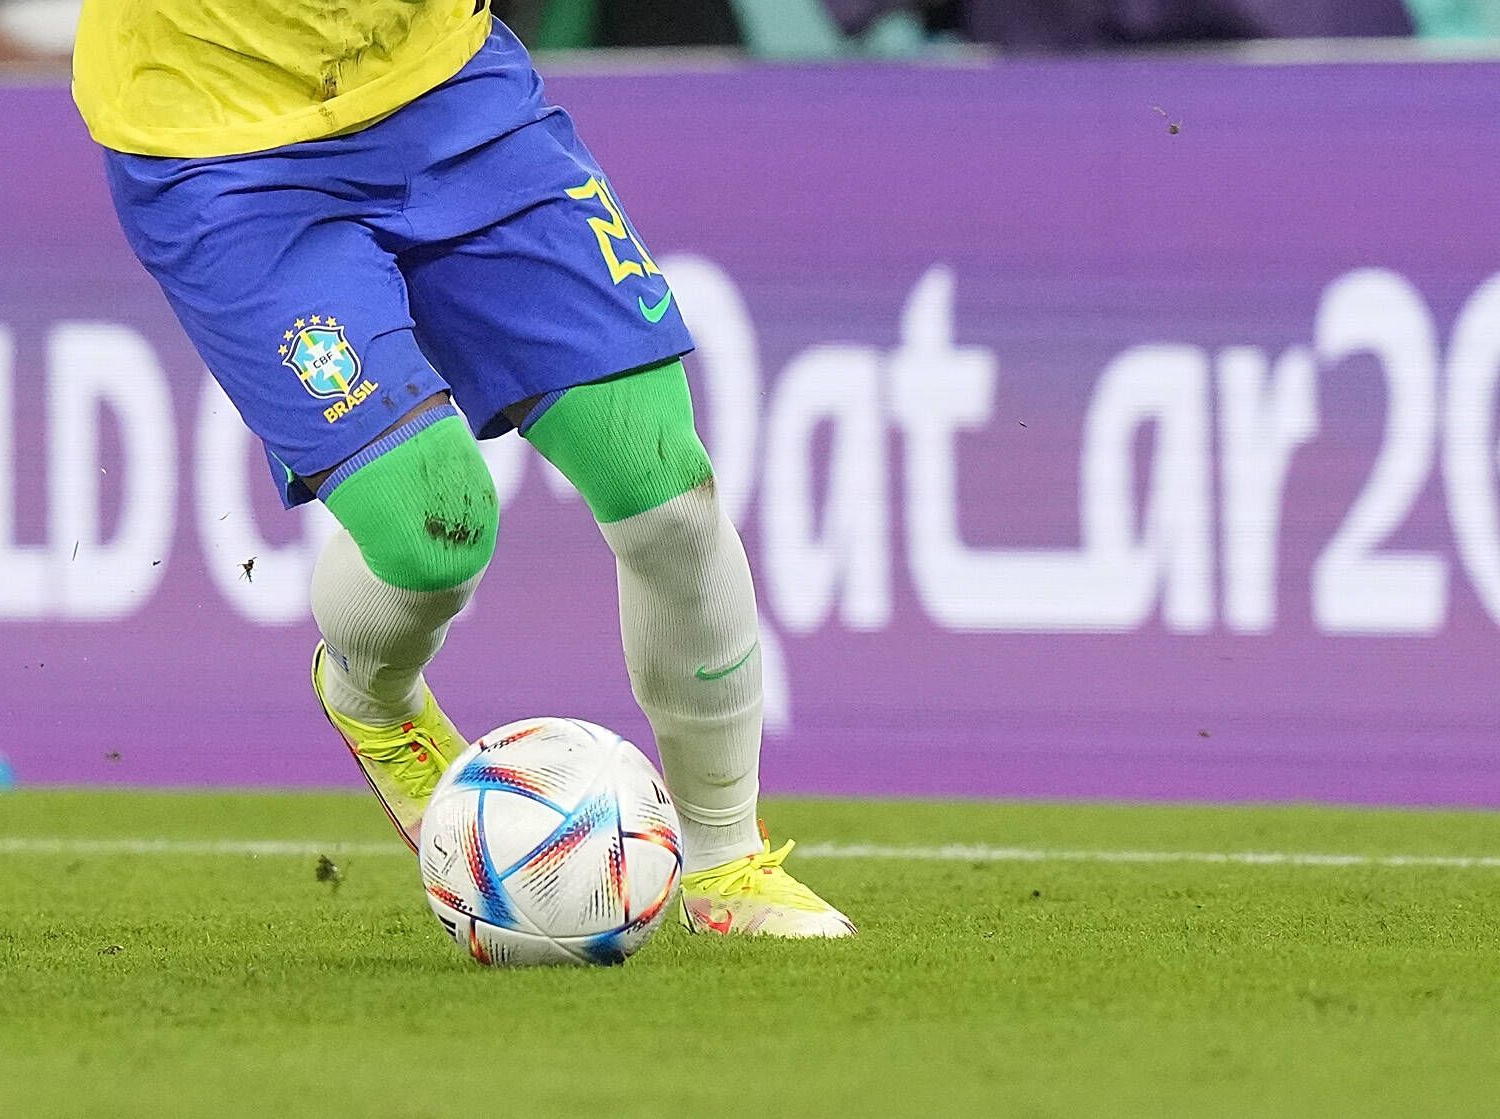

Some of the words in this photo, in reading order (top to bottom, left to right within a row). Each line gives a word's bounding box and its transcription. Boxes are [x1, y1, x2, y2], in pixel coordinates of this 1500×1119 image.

[563, 175, 662, 286] 2
[312, 351, 334, 369] CBF
[323, 379, 379, 424] BRASIL
